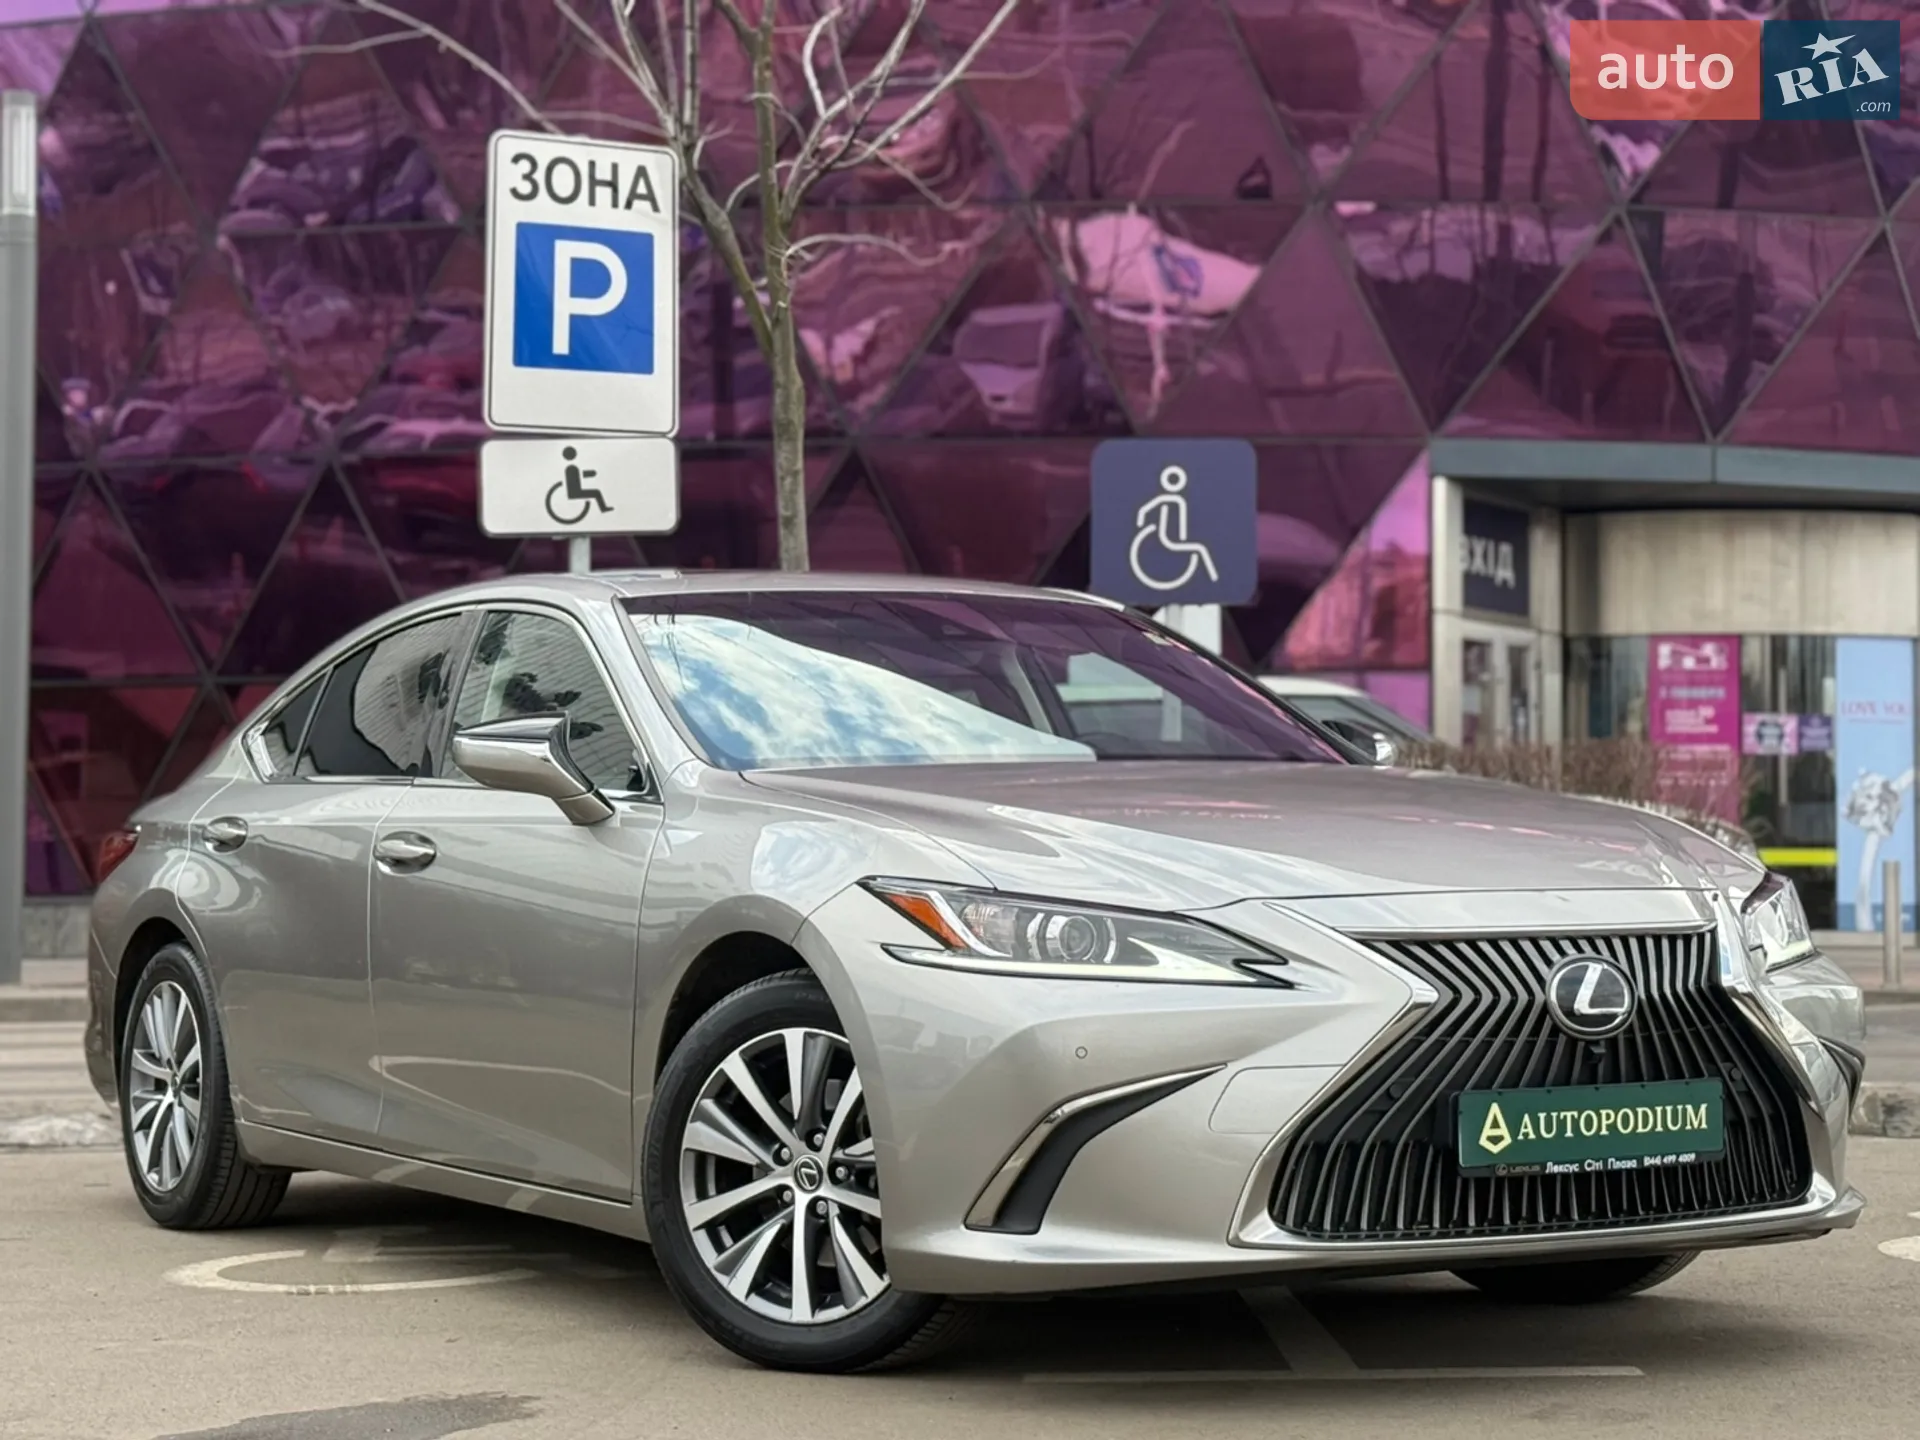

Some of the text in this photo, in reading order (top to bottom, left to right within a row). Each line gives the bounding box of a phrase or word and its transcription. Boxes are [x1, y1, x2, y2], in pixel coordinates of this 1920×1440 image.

[508, 152, 661, 214] ЗОНА
[551, 239, 628, 356] P
[1516, 1102, 1709, 1141] AUTOPODIUM
